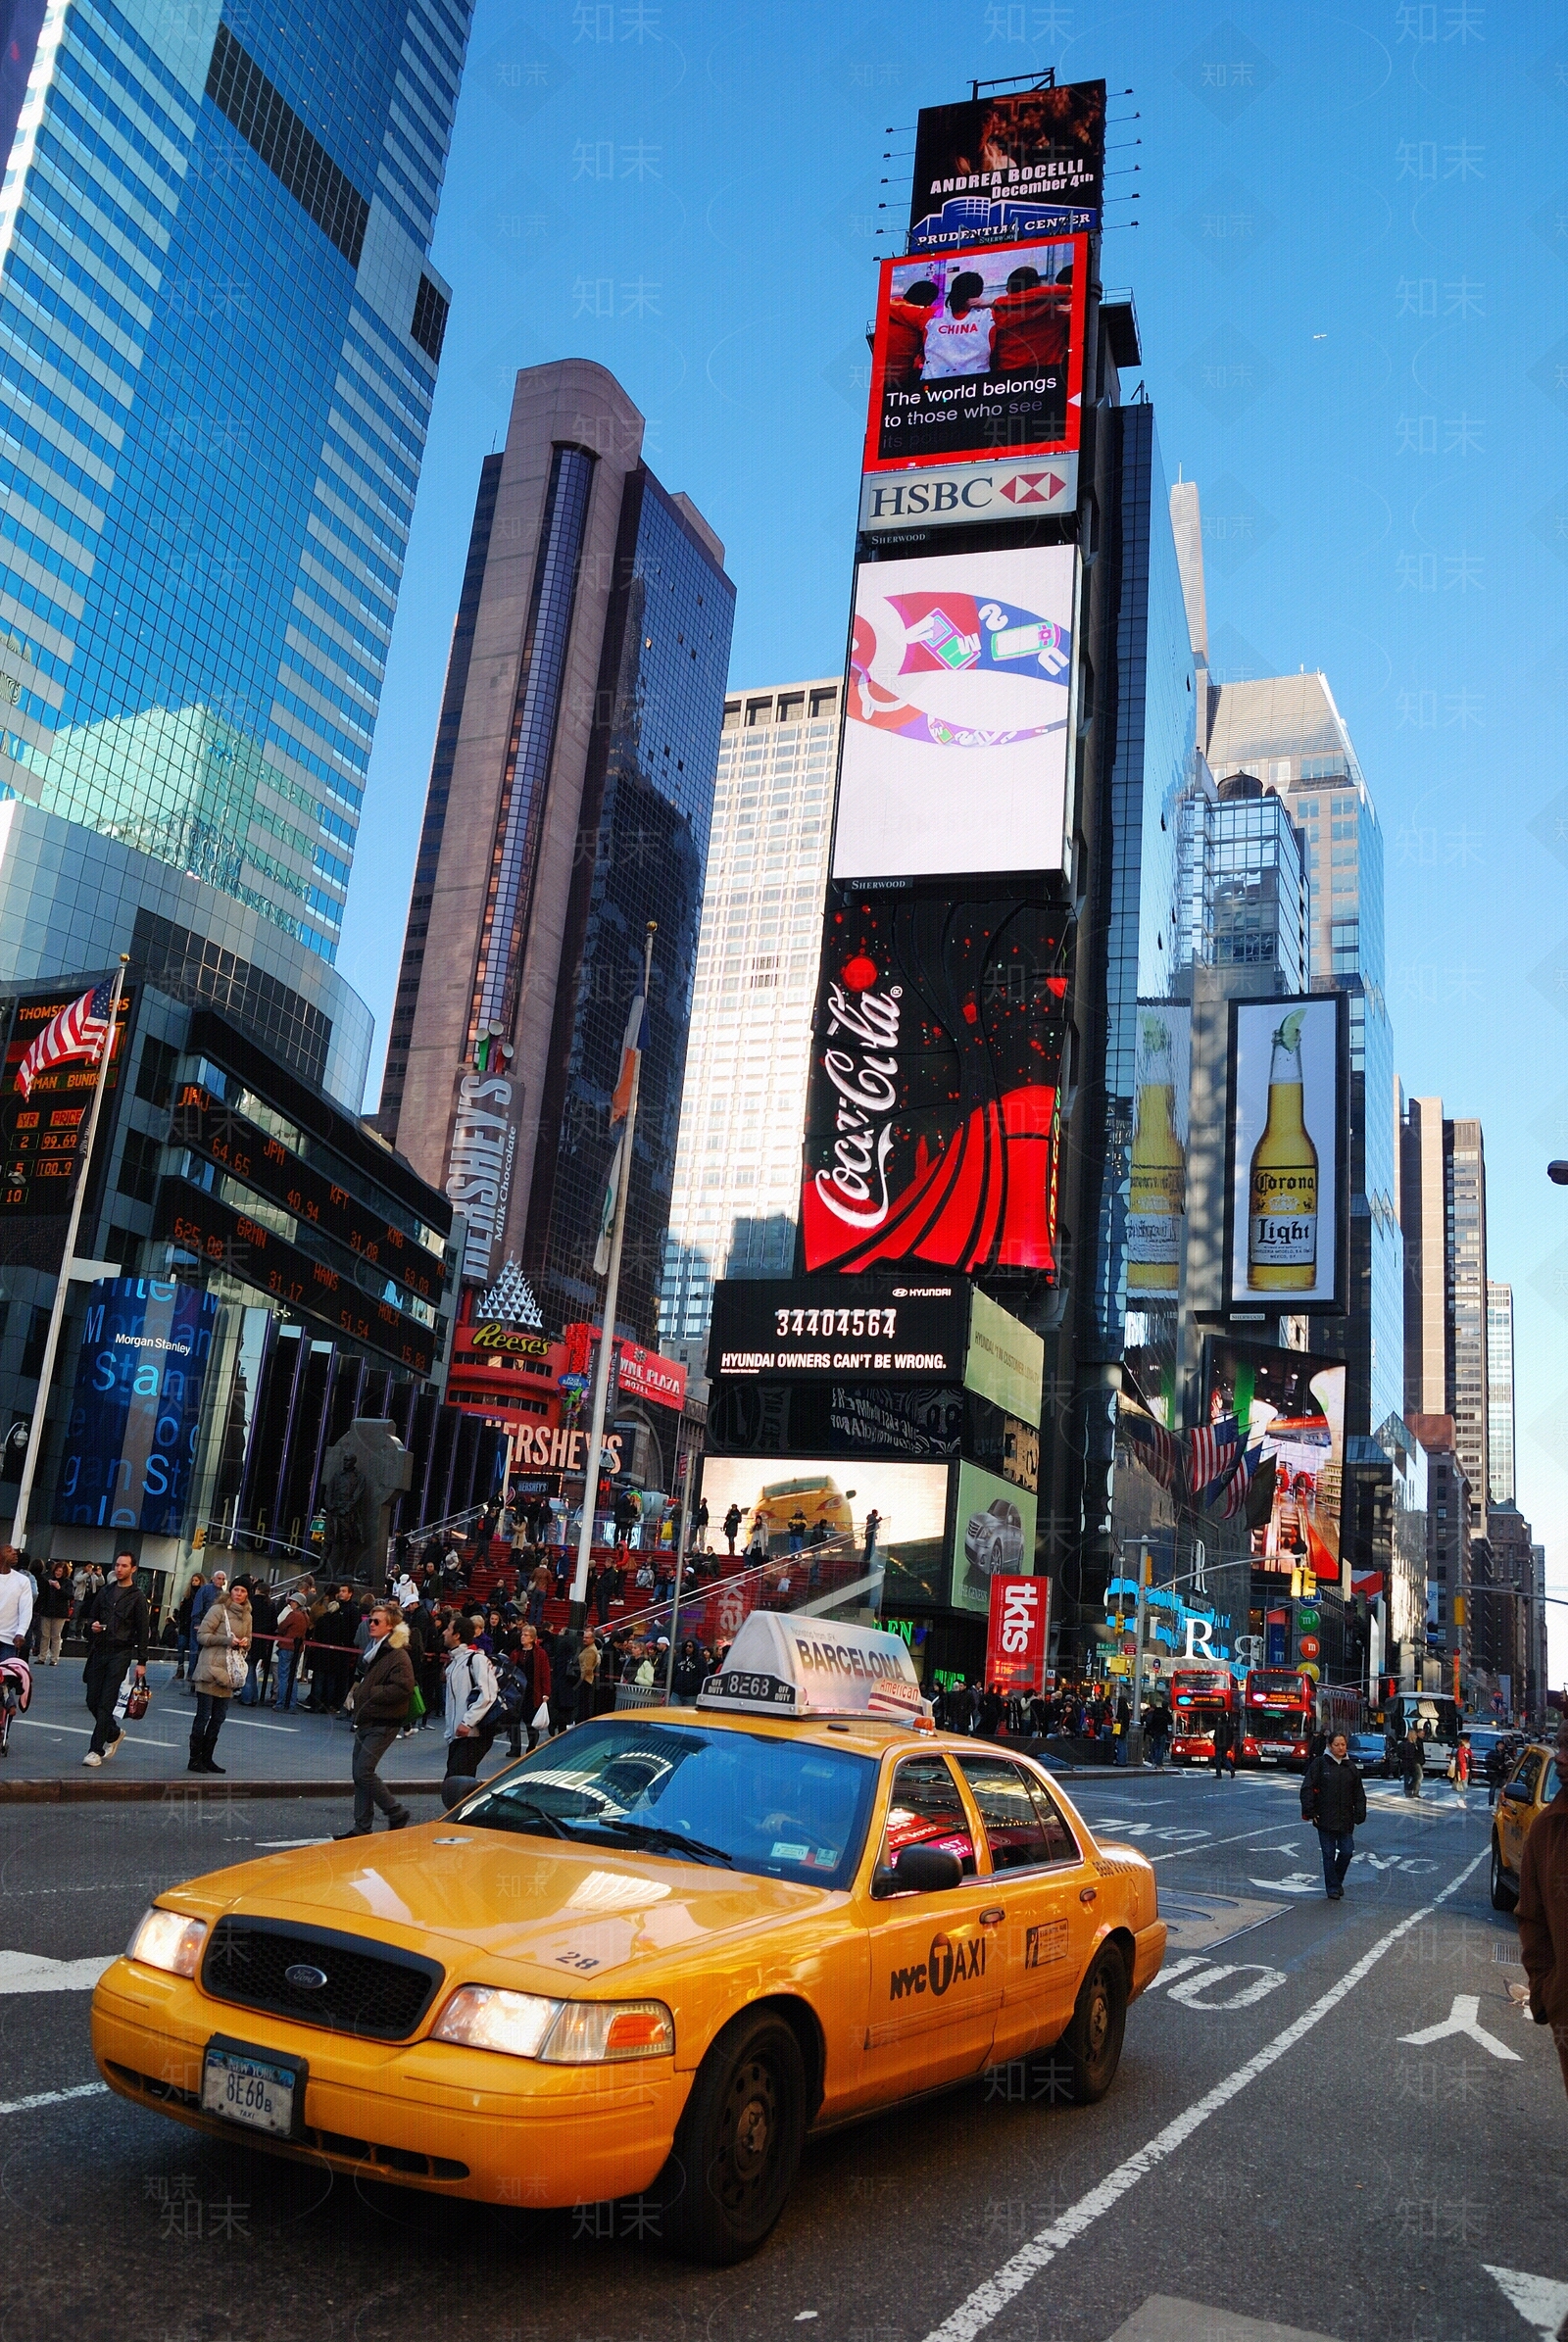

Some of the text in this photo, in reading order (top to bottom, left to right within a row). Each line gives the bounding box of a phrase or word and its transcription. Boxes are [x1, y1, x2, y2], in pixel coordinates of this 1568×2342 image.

[931, 160, 1084, 194] ANDREA BOCELLI
[991, 172, 1094, 199] December 4th
[1025, 213, 1091, 231] CENTER
[979, 233, 1015, 245] SHERWOO
[938, 322, 978, 335] CHINA
[886, 376, 1057, 407] The world belongs
[884, 399, 1043, 428] to those who see
[869, 476, 994, 518] HSBC
[871, 532, 926, 545] SHERWOOD
[851, 878, 906, 890] SHERWOOD
[19, 1004, 66, 1021] THOMSO
[814, 981, 901, 1229] Coca-Cola
[21, 1113, 36, 1127] YR
[21, 1136, 29, 1148] 2
[264, 1139, 285, 1166] JPM
[494, 1126, 516, 1243] Milk Chocolate
[1253, 1172, 1315, 1195] Corona
[6, 1189, 23, 1202] 10
[330, 1184, 350, 1209] KFT
[1257, 1218, 1309, 1244] Light
[909, 1288, 952, 1297] HYUNDAI
[115, 1333, 191, 1356] Morgan Stanley
[472, 1323, 552, 1356] Reese's
[721, 1352, 947, 1370] HYUNDAI OWNERS CAN'T BE WRONG.
[646, 1368, 681, 1394] PLAZA
[485, 1419, 623, 1475] ERSHES
[1002, 1583, 1038, 1653] tkts
[1182, 1618, 1226, 1661] R
[796, 1638, 906, 1682] BARCELONA
[709, 1685, 724, 1694] DUTY
[711, 1679, 722, 1687] OFF
[729, 1675, 769, 1697] 8E68
[880, 1679, 919, 1701] American
[774, 1692, 791, 1702] DUTY
[555, 1952, 600, 1970] 28
[890, 1964, 927, 2000] NYC
[930, 1934, 985, 1994] TAXI
[293, 1969, 316, 1983] Ford
[228, 2060, 274, 2079] NEW YORK
[239, 2110, 256, 2120] TAXI
